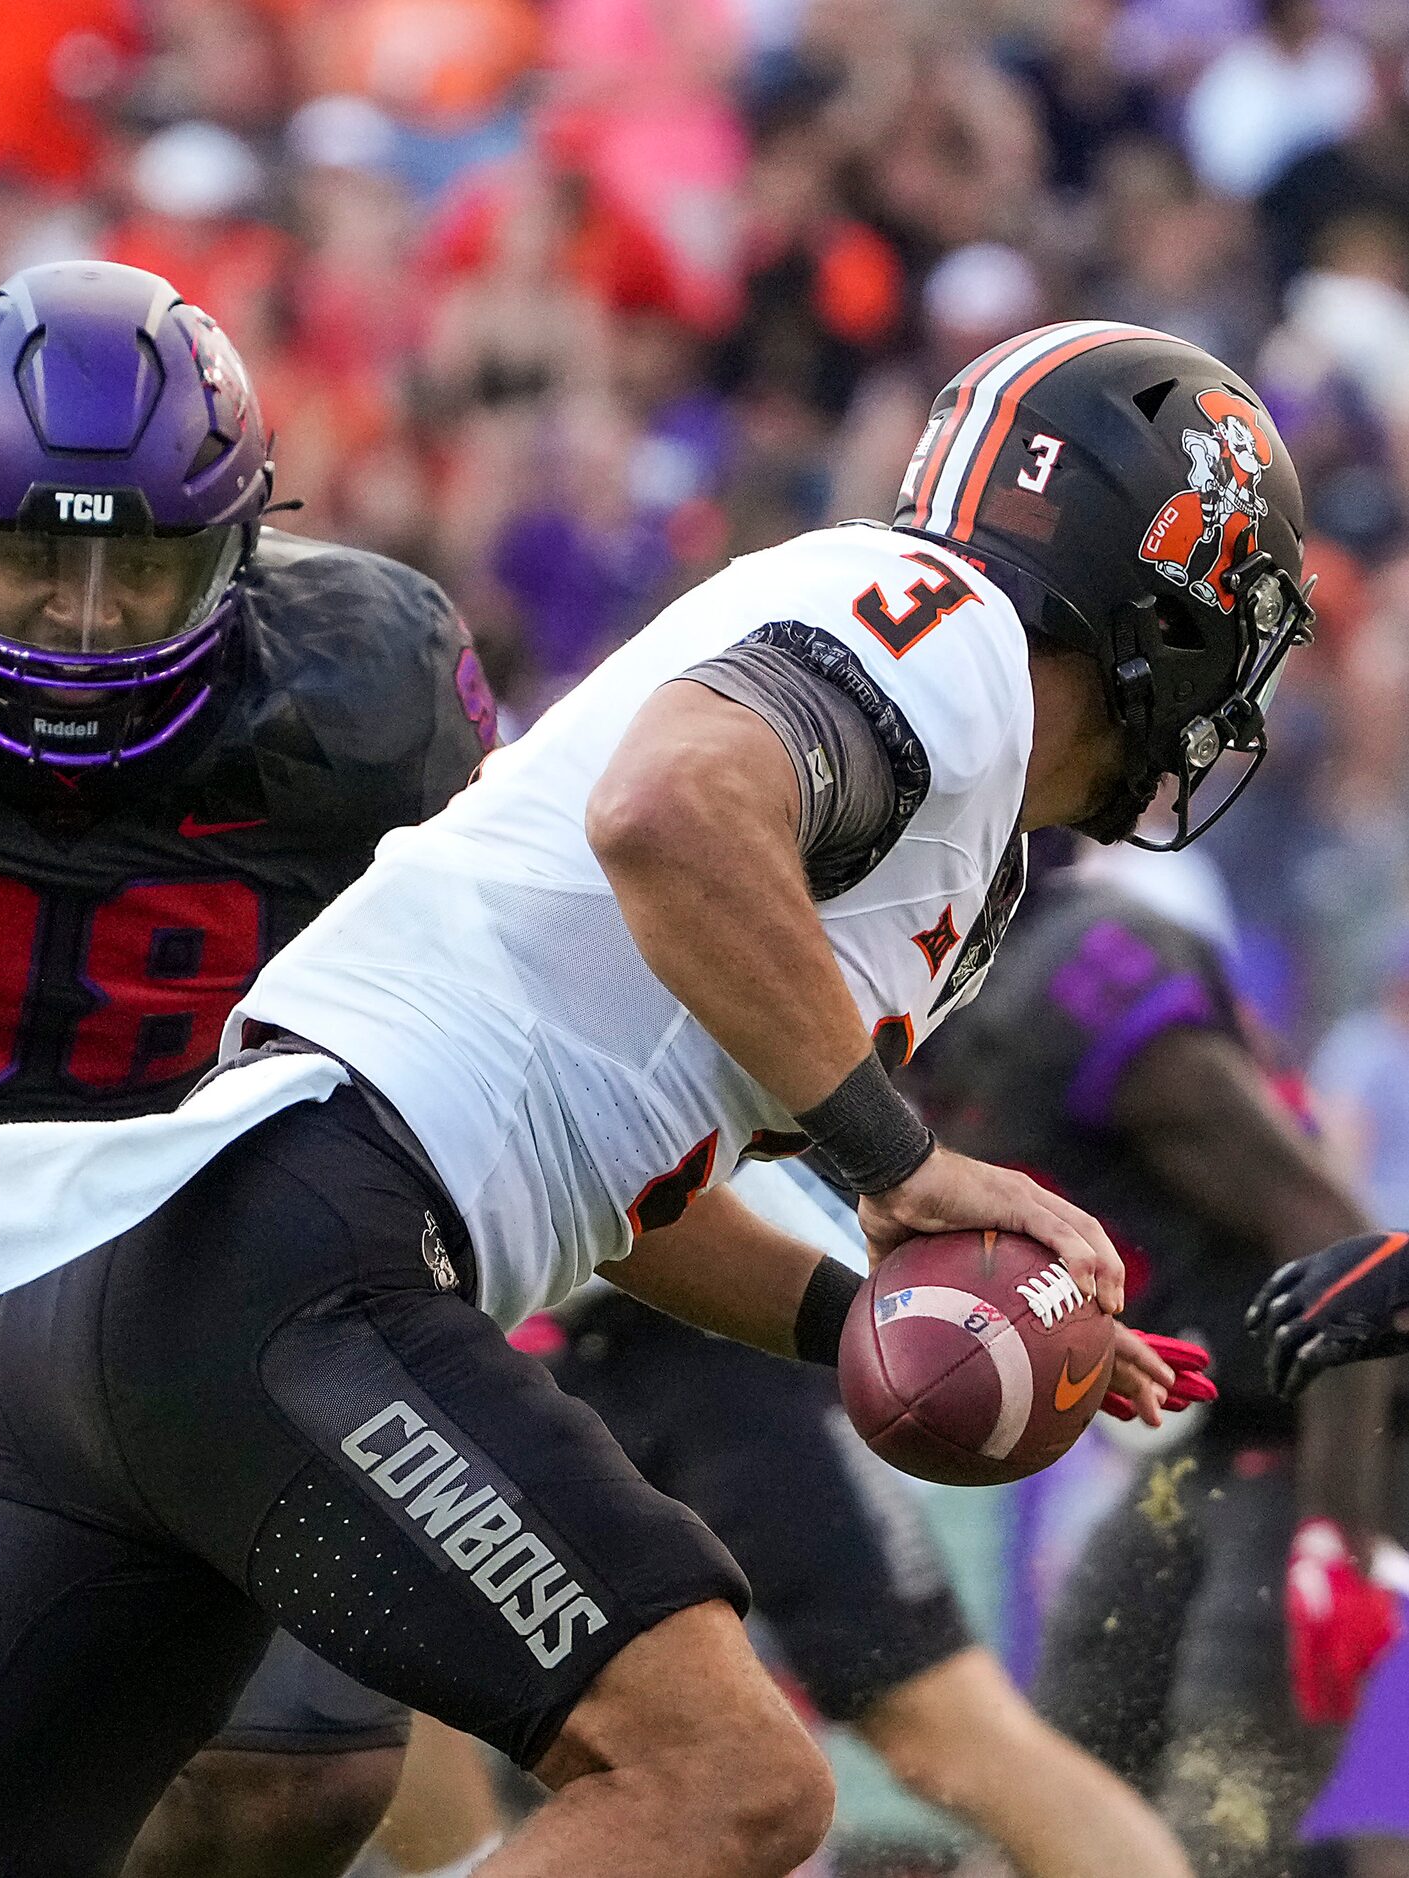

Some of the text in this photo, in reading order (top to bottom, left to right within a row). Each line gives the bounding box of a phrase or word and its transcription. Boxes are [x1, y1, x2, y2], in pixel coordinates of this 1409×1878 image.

[1016, 433, 1068, 494] 3
[55, 492, 114, 523] TCU
[1146, 506, 1180, 553] OSU
[852, 550, 985, 661] 3
[33, 717, 99, 737] Riddell
[341, 1400, 609, 1670] COWBOYS
